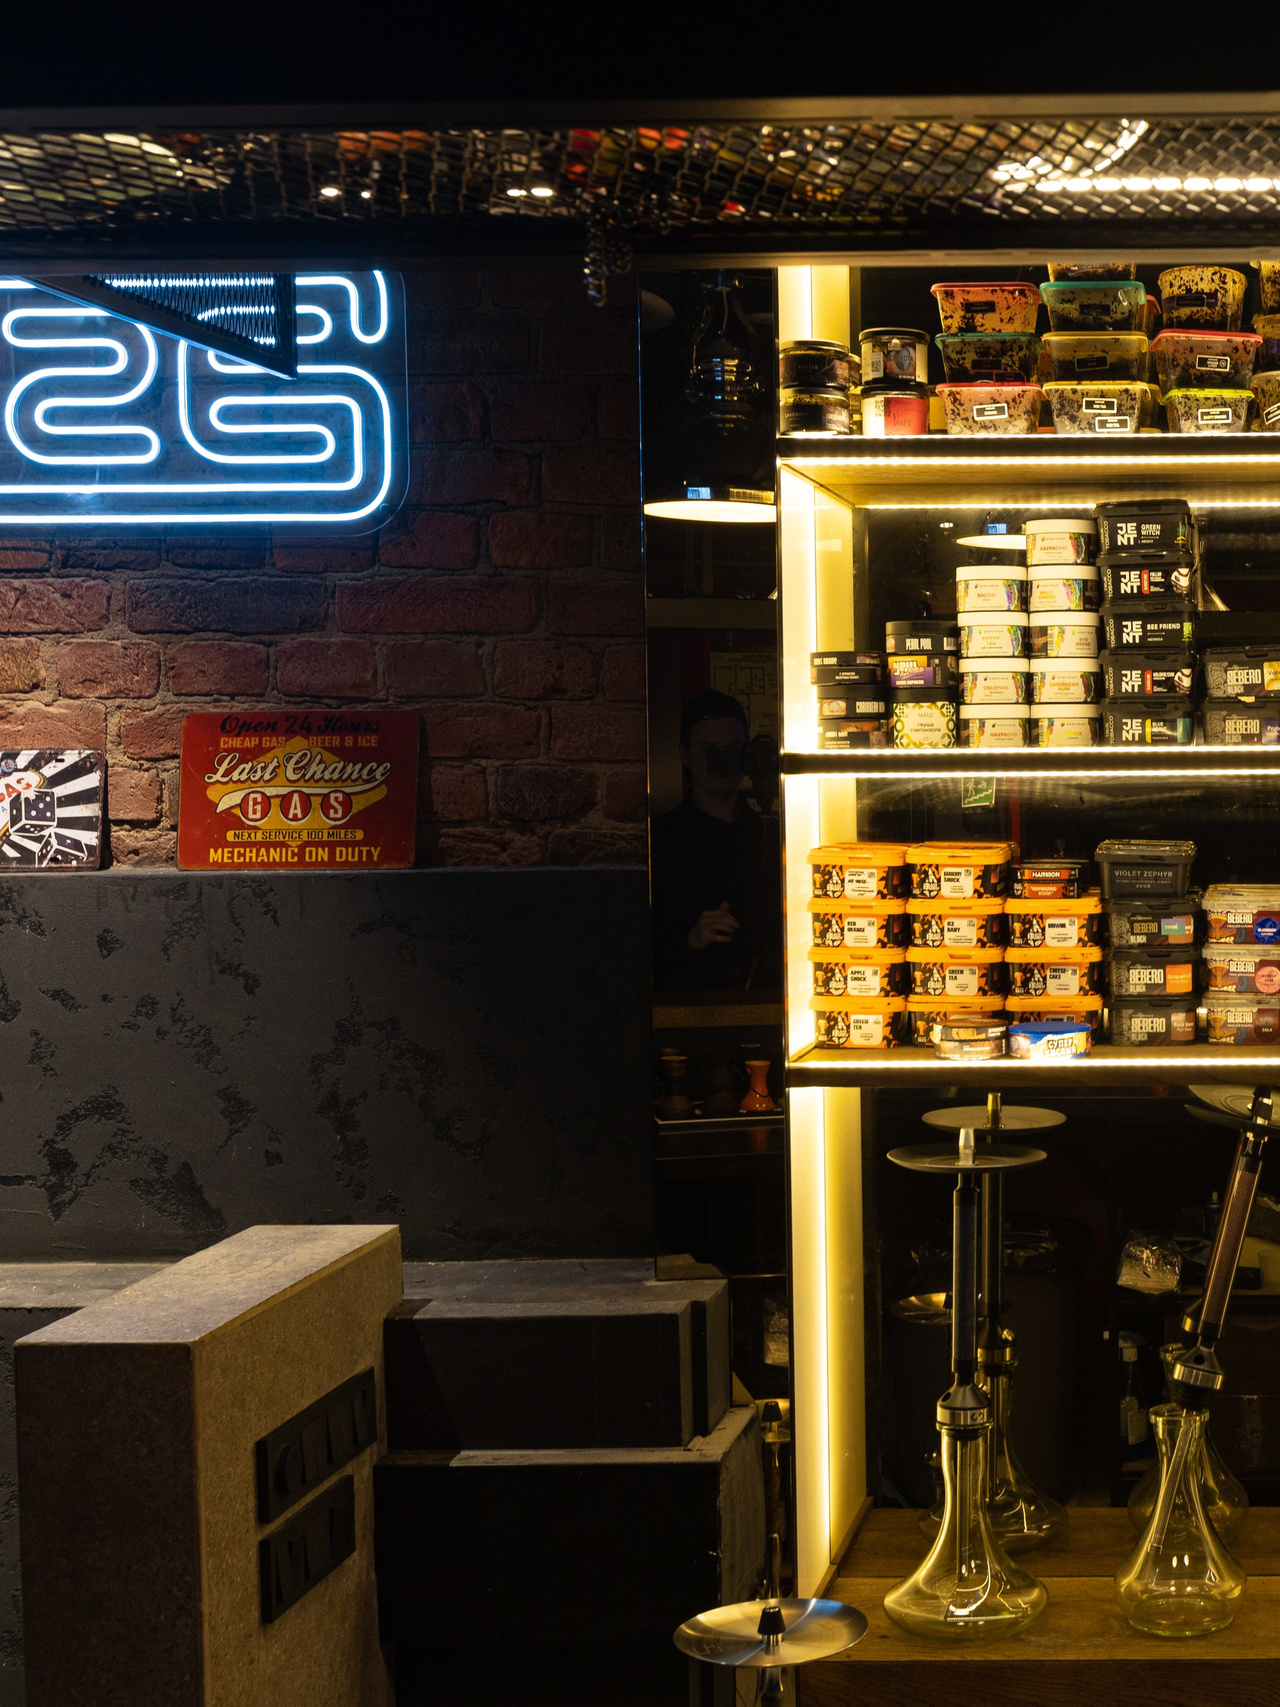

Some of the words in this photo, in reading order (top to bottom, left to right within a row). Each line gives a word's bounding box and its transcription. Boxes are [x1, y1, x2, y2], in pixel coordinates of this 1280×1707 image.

[906, 638, 919, 650] PEARL
[920, 638, 932, 650] POOL
[1227, 669, 1261, 685] SEBERO
[220, 715, 278, 736] Open
[284, 716, 312, 733] 24
[317, 715, 380, 733] Hours
[1226, 719, 1260, 735] SEBERO
[220, 737, 259, 748] CHEAP
[262, 737, 286, 748] GAS
[309, 736, 340, 748] BEER
[345, 737, 353, 747] &
[358, 736, 378, 747] ICE
[204, 752, 279, 783] Last
[283, 749, 392, 782] Chance
[248, 793, 343, 818] GAS
[233, 831, 259, 840] NEXT
[261, 831, 303, 840] SERVICE
[307, 831, 324, 840] 100
[327, 830, 357, 840] MILES
[209, 847, 298, 863] MECHANIC
[305, 848, 329, 862] ON
[335, 847, 381, 862] DUTY
[1134, 922, 1158, 933] SEBERO
[1130, 969, 1164, 984] SEBERO
[1132, 1018, 1166, 1032] SEBERO
[1048, 1040, 1072, 1049] СУПЕР
